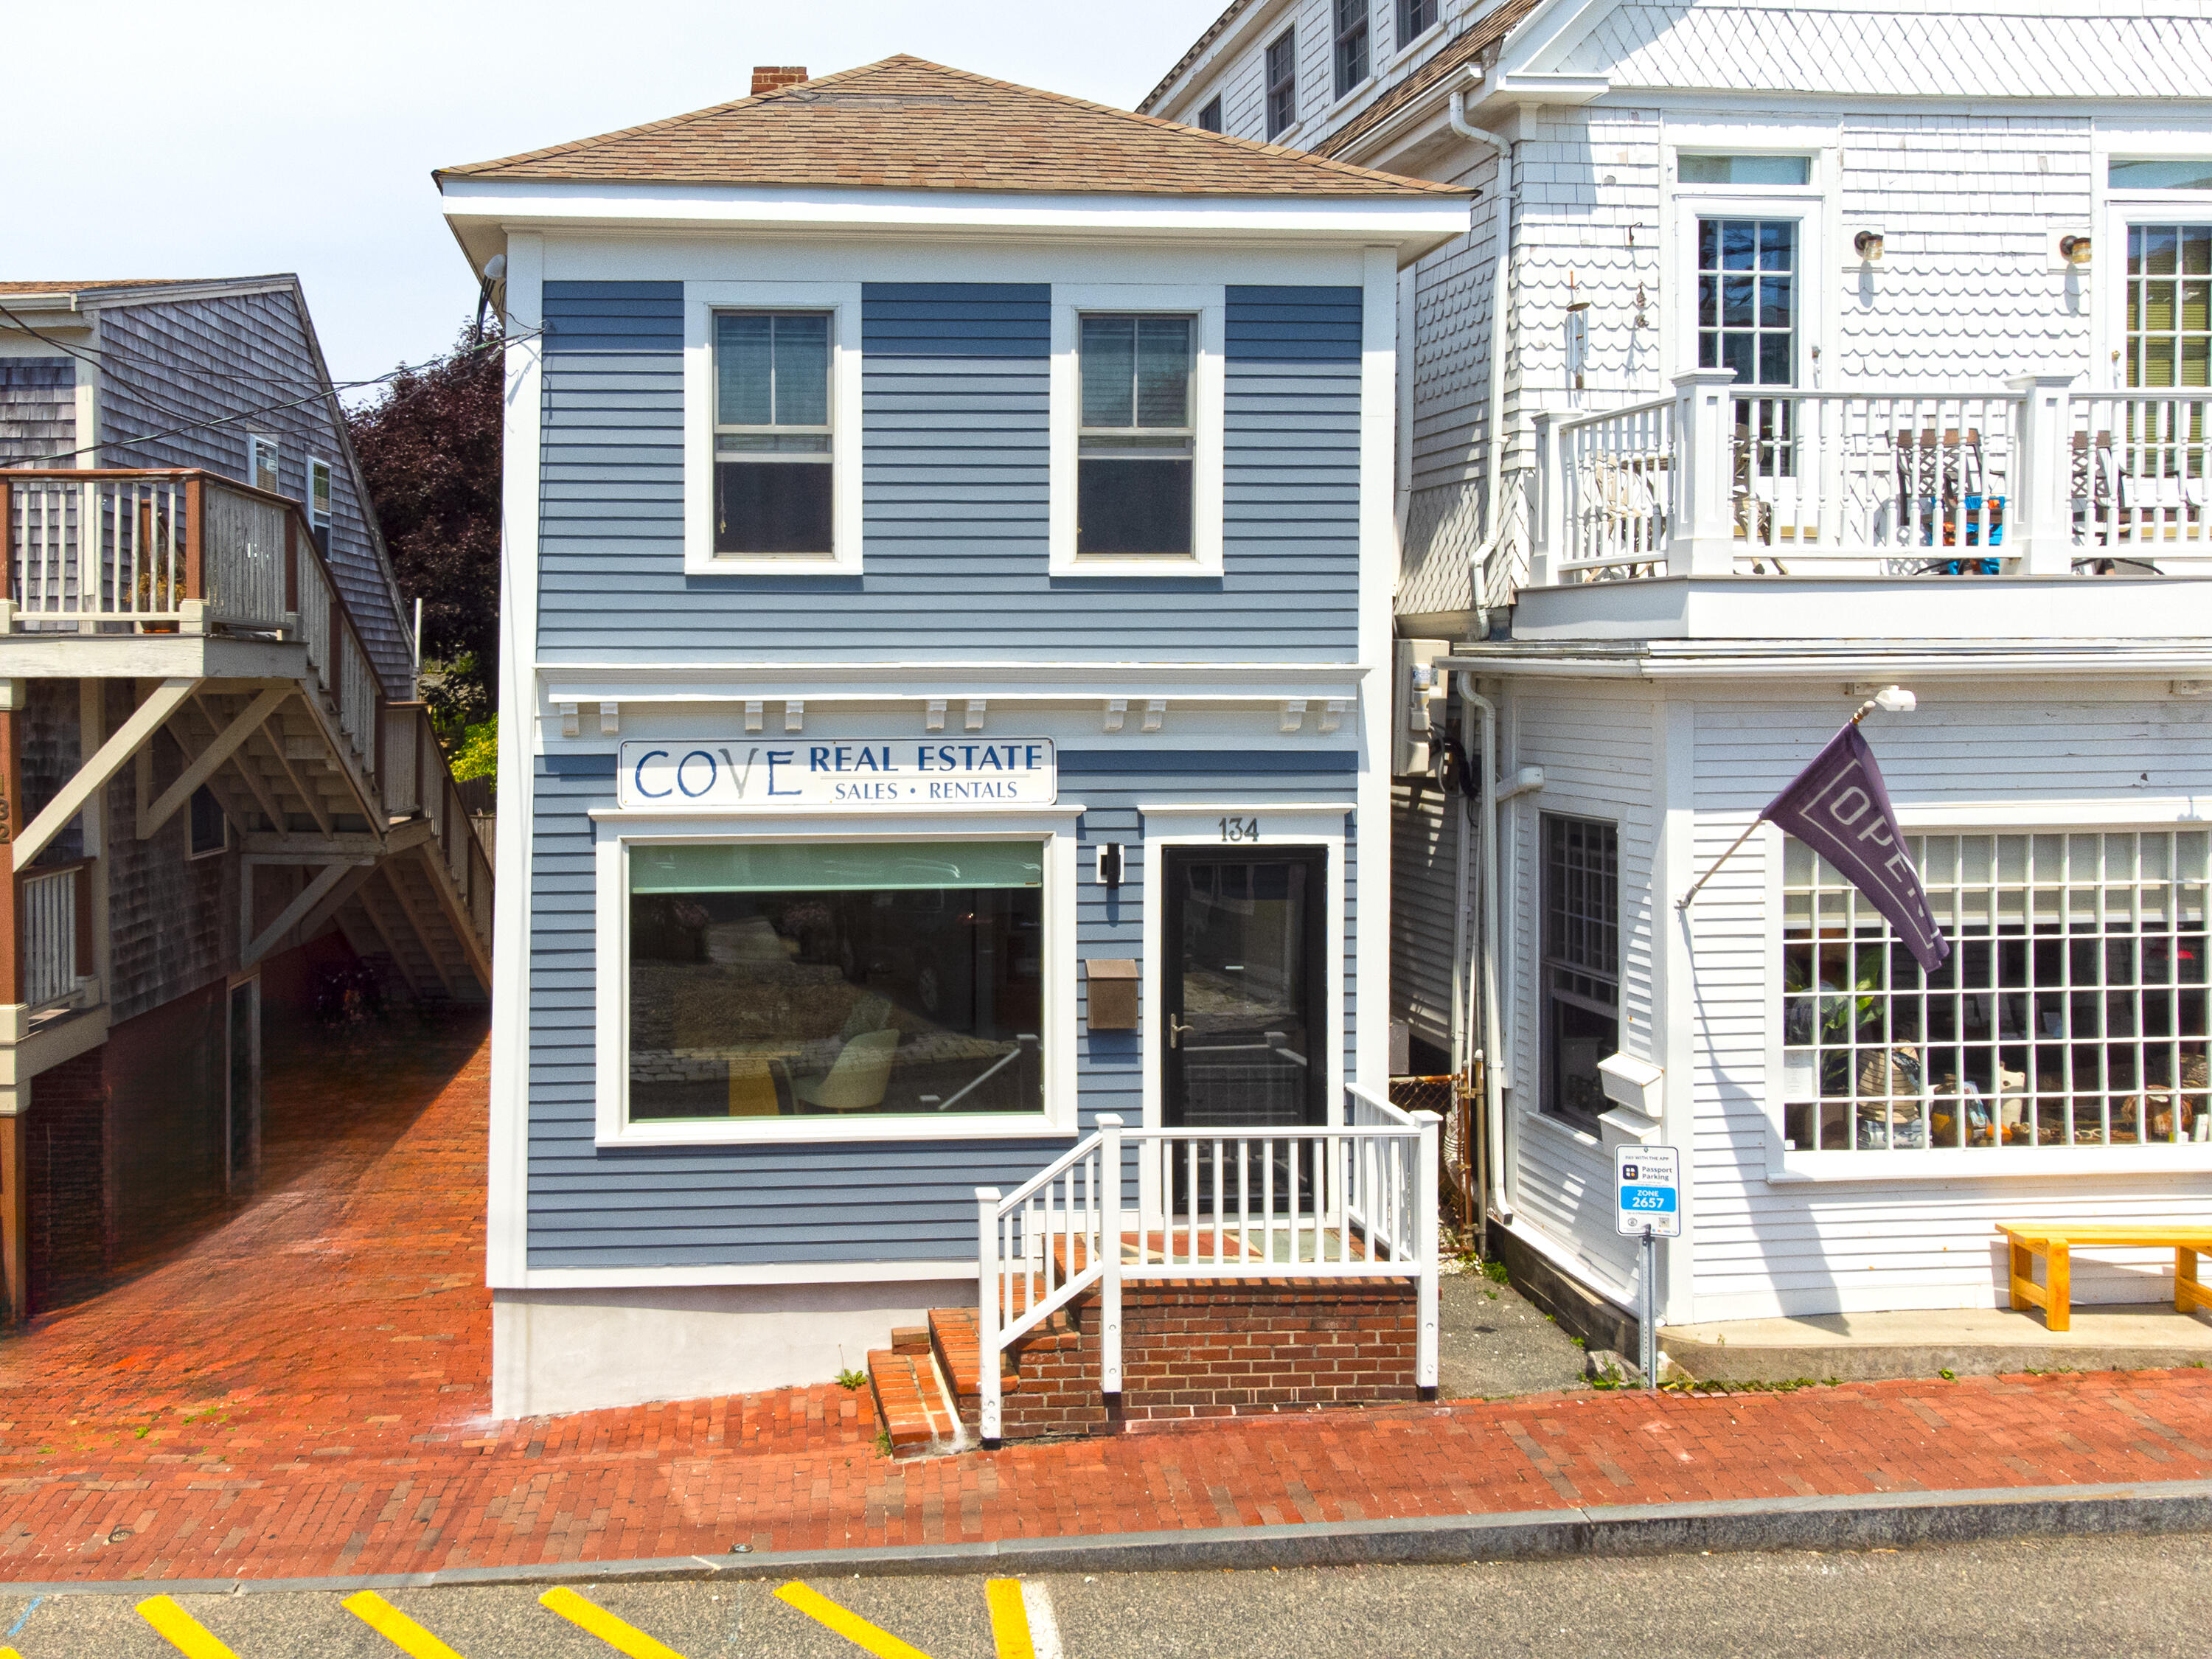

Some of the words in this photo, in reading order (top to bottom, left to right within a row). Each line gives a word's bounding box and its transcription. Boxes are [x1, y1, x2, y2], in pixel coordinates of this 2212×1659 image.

[635, 748, 802, 799] COVE
[810, 746, 899, 772] REAL
[918, 745, 1042, 771] ESTATE
[835, 782, 898, 800] SALES
[930, 781, 1018, 799] RENTALS
[1219, 818, 1259, 842] 134
[1829, 786, 1926, 918] OPE
[1642, 1166, 1673, 1174] Passport
[1642, 1173, 1669, 1182] Parking
[1637, 1189, 1659, 1197] ZONE
[1632, 1197, 1665, 1208] 2657
